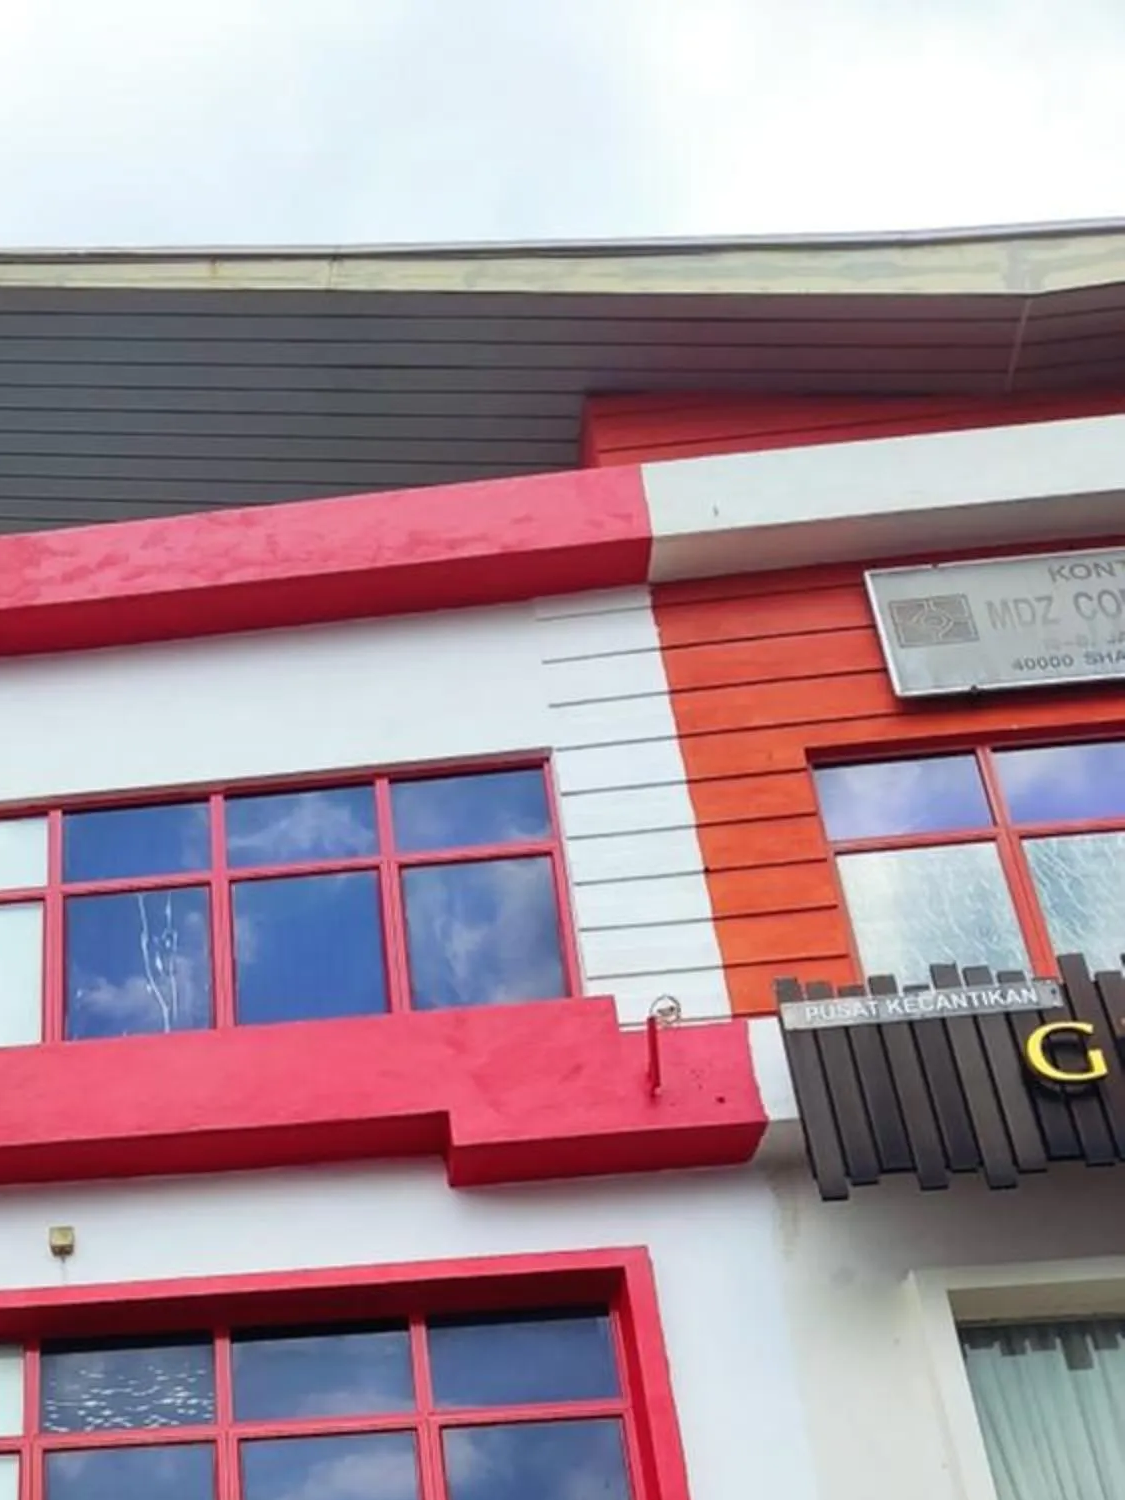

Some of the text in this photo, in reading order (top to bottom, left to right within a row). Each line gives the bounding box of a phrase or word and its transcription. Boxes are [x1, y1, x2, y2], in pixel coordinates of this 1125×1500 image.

[986, 595, 1061, 630] MDZ
[805, 987, 1038, 1022] PUSAT KECANTIKAN
